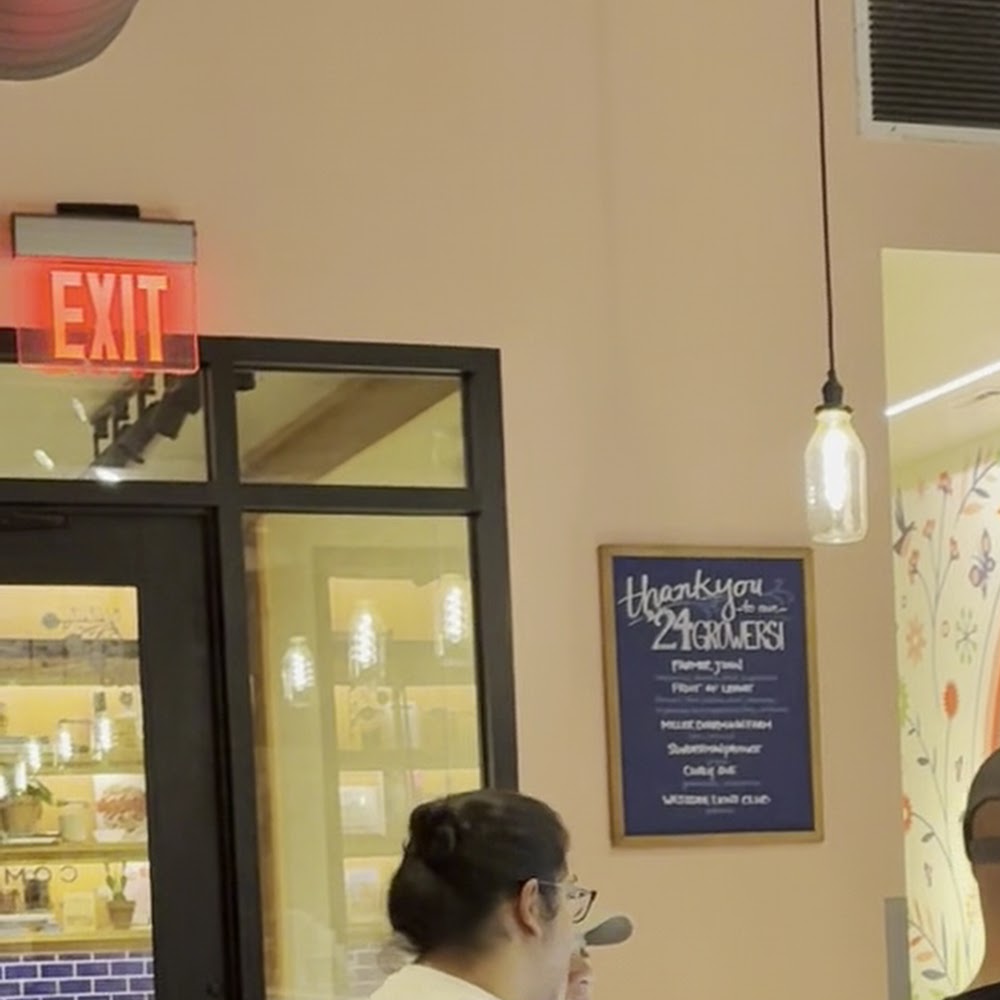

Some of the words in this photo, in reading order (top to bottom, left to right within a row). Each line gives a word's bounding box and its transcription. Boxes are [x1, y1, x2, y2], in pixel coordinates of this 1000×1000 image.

[51, 270, 168, 362] EXIT
[617, 569, 712, 622] thank
[711, 577, 763, 622] you
[651, 607, 693, 651] 24
